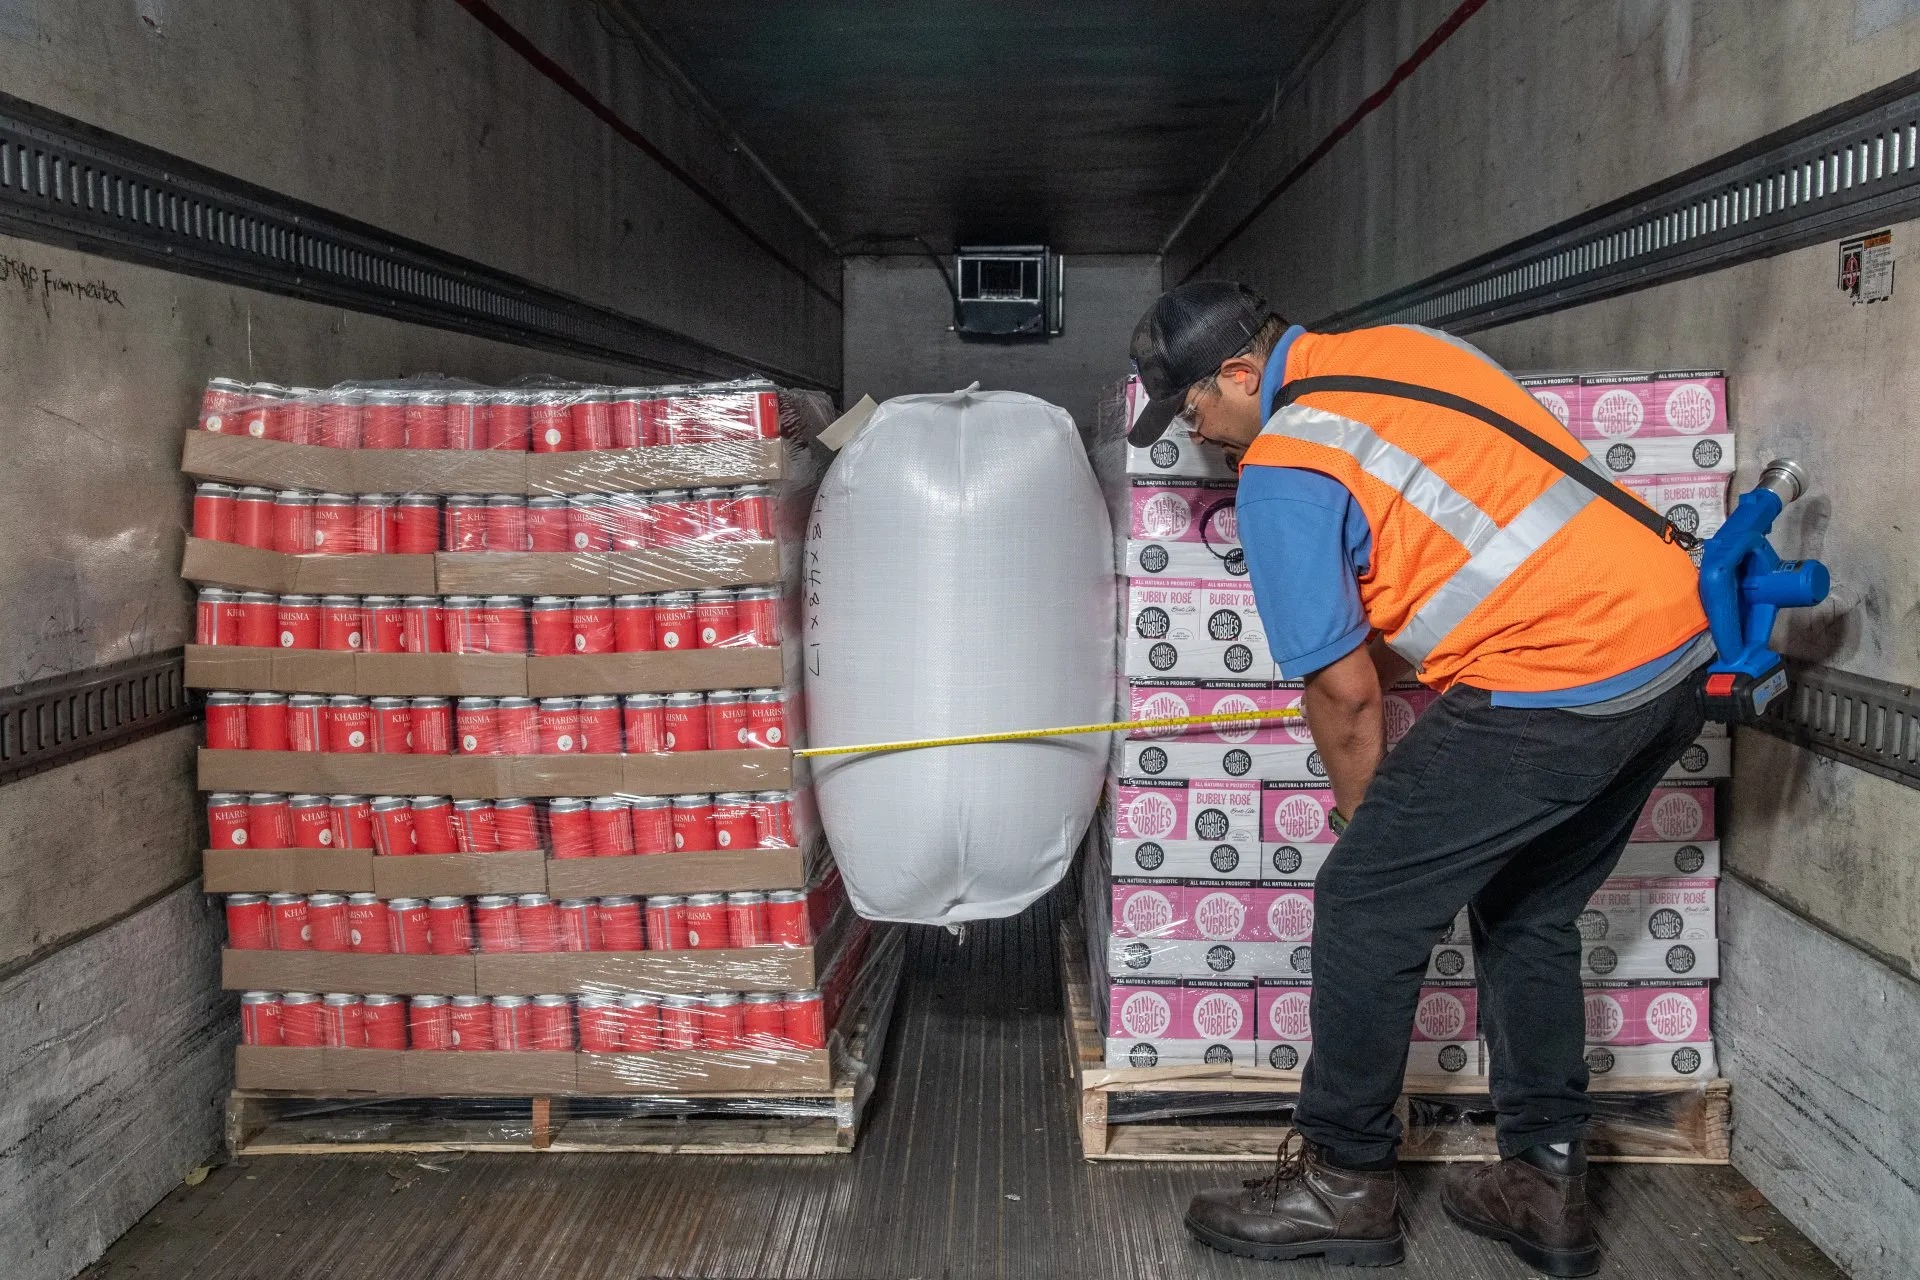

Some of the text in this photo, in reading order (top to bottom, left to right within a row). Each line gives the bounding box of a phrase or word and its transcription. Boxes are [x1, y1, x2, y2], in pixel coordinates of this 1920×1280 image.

[1604, 394, 1627, 412] TINY
[1678, 389, 1700, 408] TINY
[1598, 404, 1638, 434] BUBBLES
[1670, 398, 1710, 428] BUBBLES
[1612, 446, 1628, 456] TINY
[1699, 442, 1713, 453] TINY
[1608, 452, 1633, 470] BUBBLES
[1696, 448, 1720, 466] BUBBLES
[1171, 590, 1192, 604] ROSÉ
[1210, 592, 1240, 606] BUBBLY
[1144, 610, 1162, 622] TINY
[1215, 612, 1234, 624] TINY
[1138, 616, 1167, 637] BUBBLES
[1210, 619, 1238, 640] BUBBLES
[1155, 644, 1170, 655] TINY
[1230, 646, 1245, 656] TINY
[1151, 650, 1175, 668] BUBBLES
[1226, 652, 1250, 670] BUBBLES
[1141, 754, 1166, 772] BUBBLES
[1146, 749, 1160, 760] TINY
[1229, 751, 1243, 762] TINY
[1225, 756, 1249, 774] BUBBLES
[1141, 797, 1161, 816] TINY
[1196, 792, 1251, 806] BUBBLY ROSÉ
[1202, 811, 1221, 824] TINY
[1285, 799, 1309, 818] TINY
[1132, 806, 1171, 836] BUBBLES
[1198, 817, 1226, 838] BUBBLES
[1280, 806, 1320, 838] BUBBLES
[1138, 850, 1161, 868] BUBBLES
[1141, 845, 1156, 856] TINY
[1216, 846, 1230, 857] TINY
[1279, 848, 1293, 859] TINY
[1212, 852, 1236, 870] BUBBLES
[1276, 853, 1299, 871] BUBBLES
[1134, 895, 1157, 912] TINY
[1649, 890, 1706, 904] BUBBLY ROSÉ
[1207, 897, 1229, 916] TINY
[1279, 898, 1302, 915] TINY
[1200, 906, 1240, 935] BUBBLES
[1272, 908, 1312, 936] BUBBLES
[1656, 911, 1673, 923] TINY
[1652, 917, 1680, 938] BUBBLES
[1669, 952, 1692, 970] BUBBLES
[1672, 947, 1686, 958] TINY
[1132, 996, 1156, 1013] TINY
[1205, 998, 1228, 1016] TINY
[1280, 996, 1304, 1015] TINY
[1426, 998, 1450, 1014] TINY
[1657, 998, 1681, 1016] TINY
[1126, 1004, 1165, 1034] BUBBLES
[1198, 1006, 1238, 1036] BUBBLES
[1275, 1006, 1308, 1036] BUBBLE
[1420, 1007, 1460, 1036] BUBBLES
[1651, 1006, 1692, 1036] BUBBLES
[1272, 1051, 1296, 1068] BUBBLES
[1275, 1046, 1291, 1058] TINY
[1678, 1048, 1693, 1059] TINY
[1674, 1053, 1698, 1072] BUBBLES
